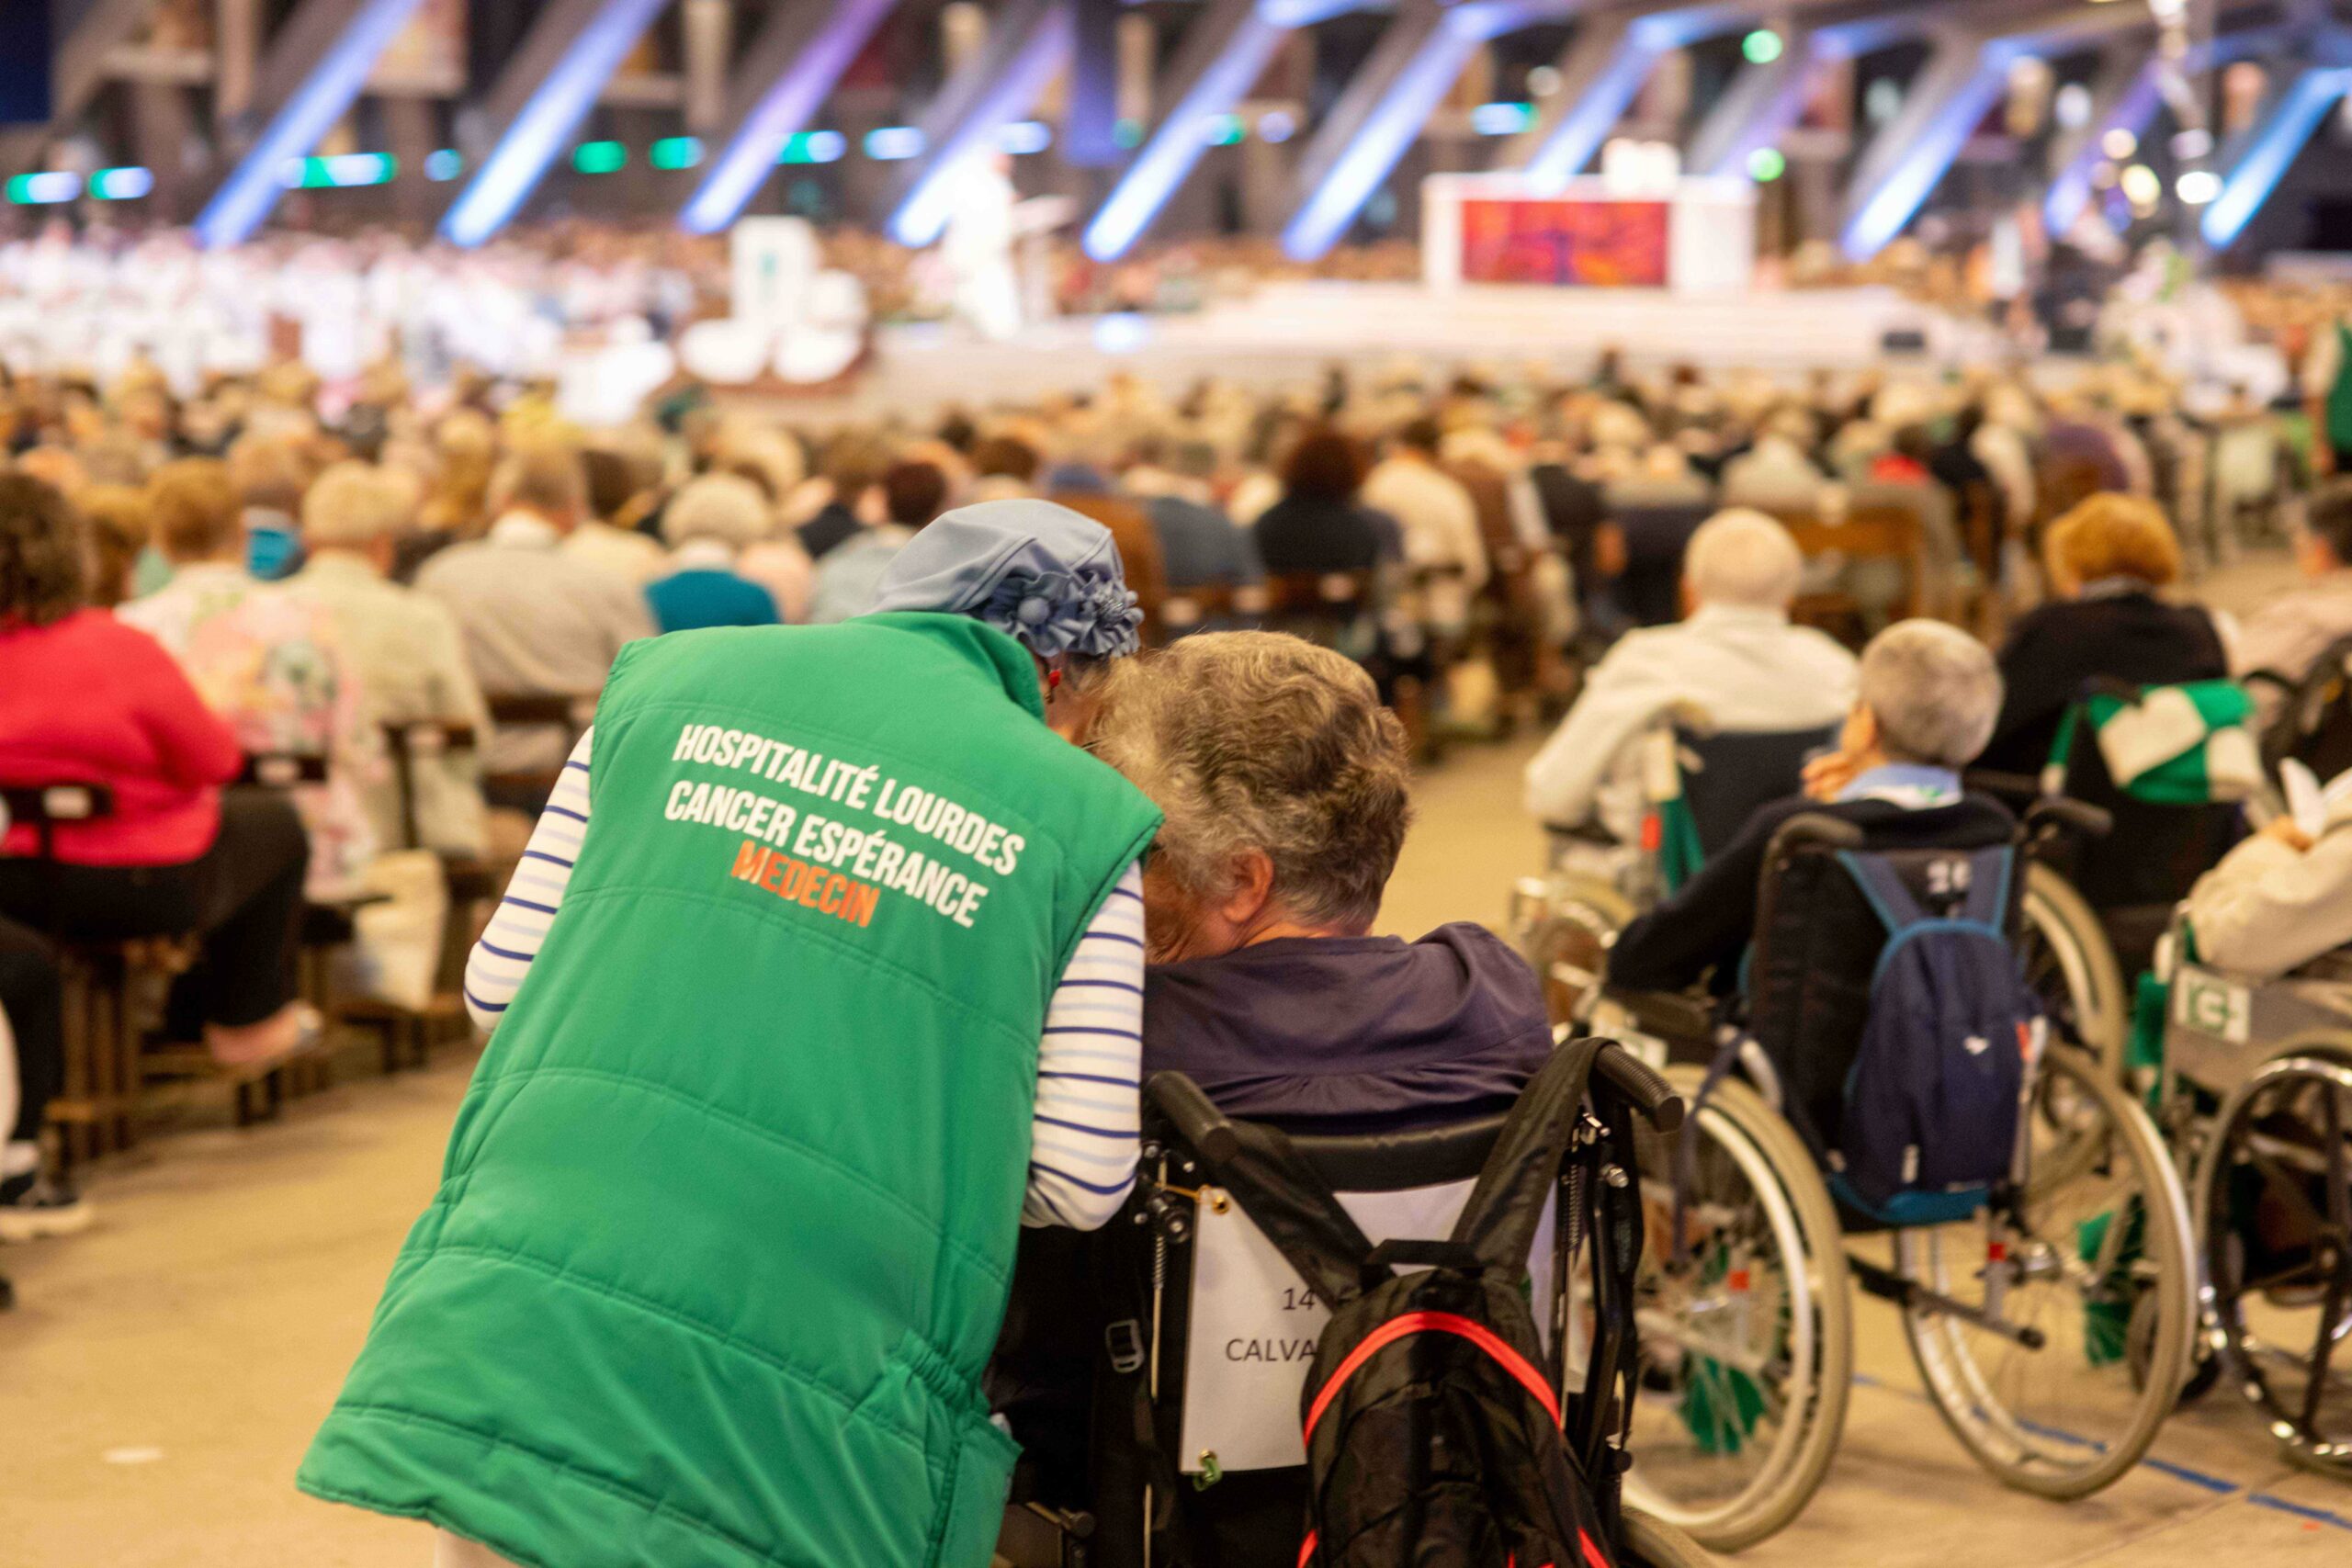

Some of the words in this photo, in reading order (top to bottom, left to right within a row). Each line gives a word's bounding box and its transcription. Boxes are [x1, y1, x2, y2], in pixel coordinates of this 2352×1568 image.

[664, 780, 797, 847] CANCER
[793, 814, 989, 929] ESPÉRANCE
[672, 724, 880, 809] HOSPITALITÉ
[873, 778, 1025, 875] LOURDES
[730, 840, 881, 928] MEDECIN
[1283, 1288, 1316, 1311] 14
